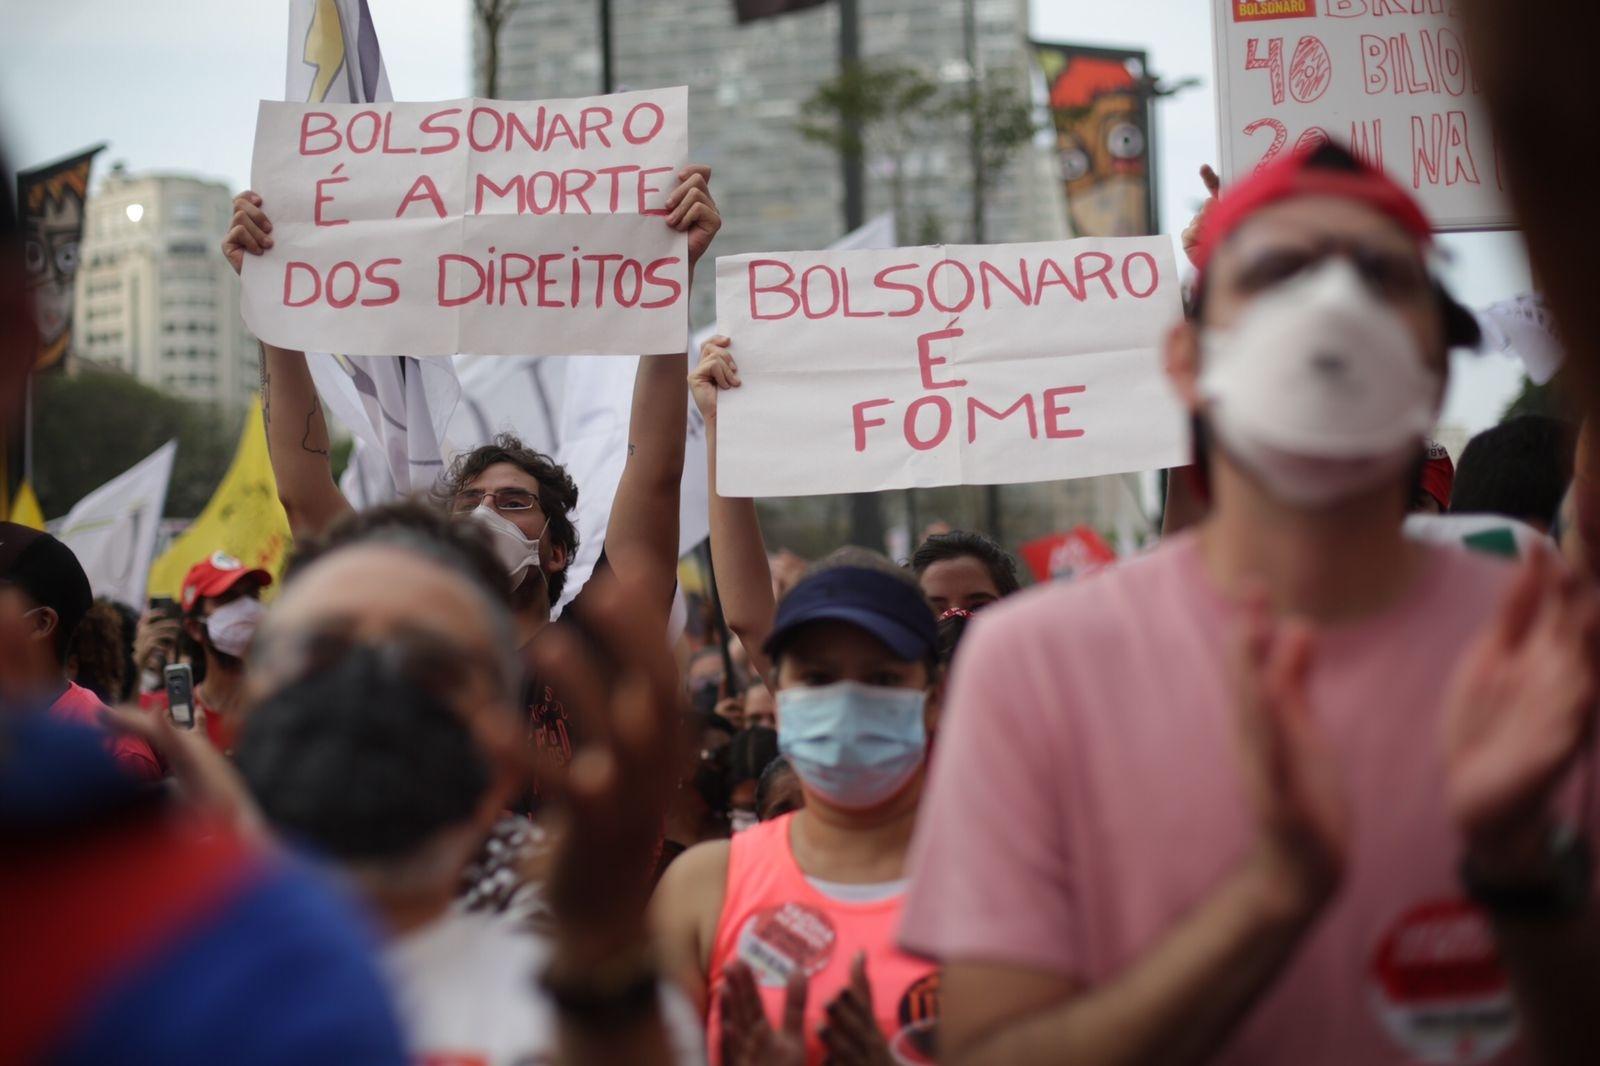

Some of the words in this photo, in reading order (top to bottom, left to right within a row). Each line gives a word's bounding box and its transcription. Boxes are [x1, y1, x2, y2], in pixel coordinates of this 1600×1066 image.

[1239, 2, 1306, 16] BOLSONARO
[1245, 35, 1332, 105] 40
[299, 102, 666, 156] BOLSONARO
[1411, 111, 1480, 189] NA
[315, 163, 350, 226] É
[396, 175, 447, 218] A
[475, 165, 675, 217] MORTE
[283, 258, 401, 309] DOS
[748, 251, 1160, 319] BOLSONARO
[917, 317, 968, 390] É
[853, 385, 1086, 453] FOME
